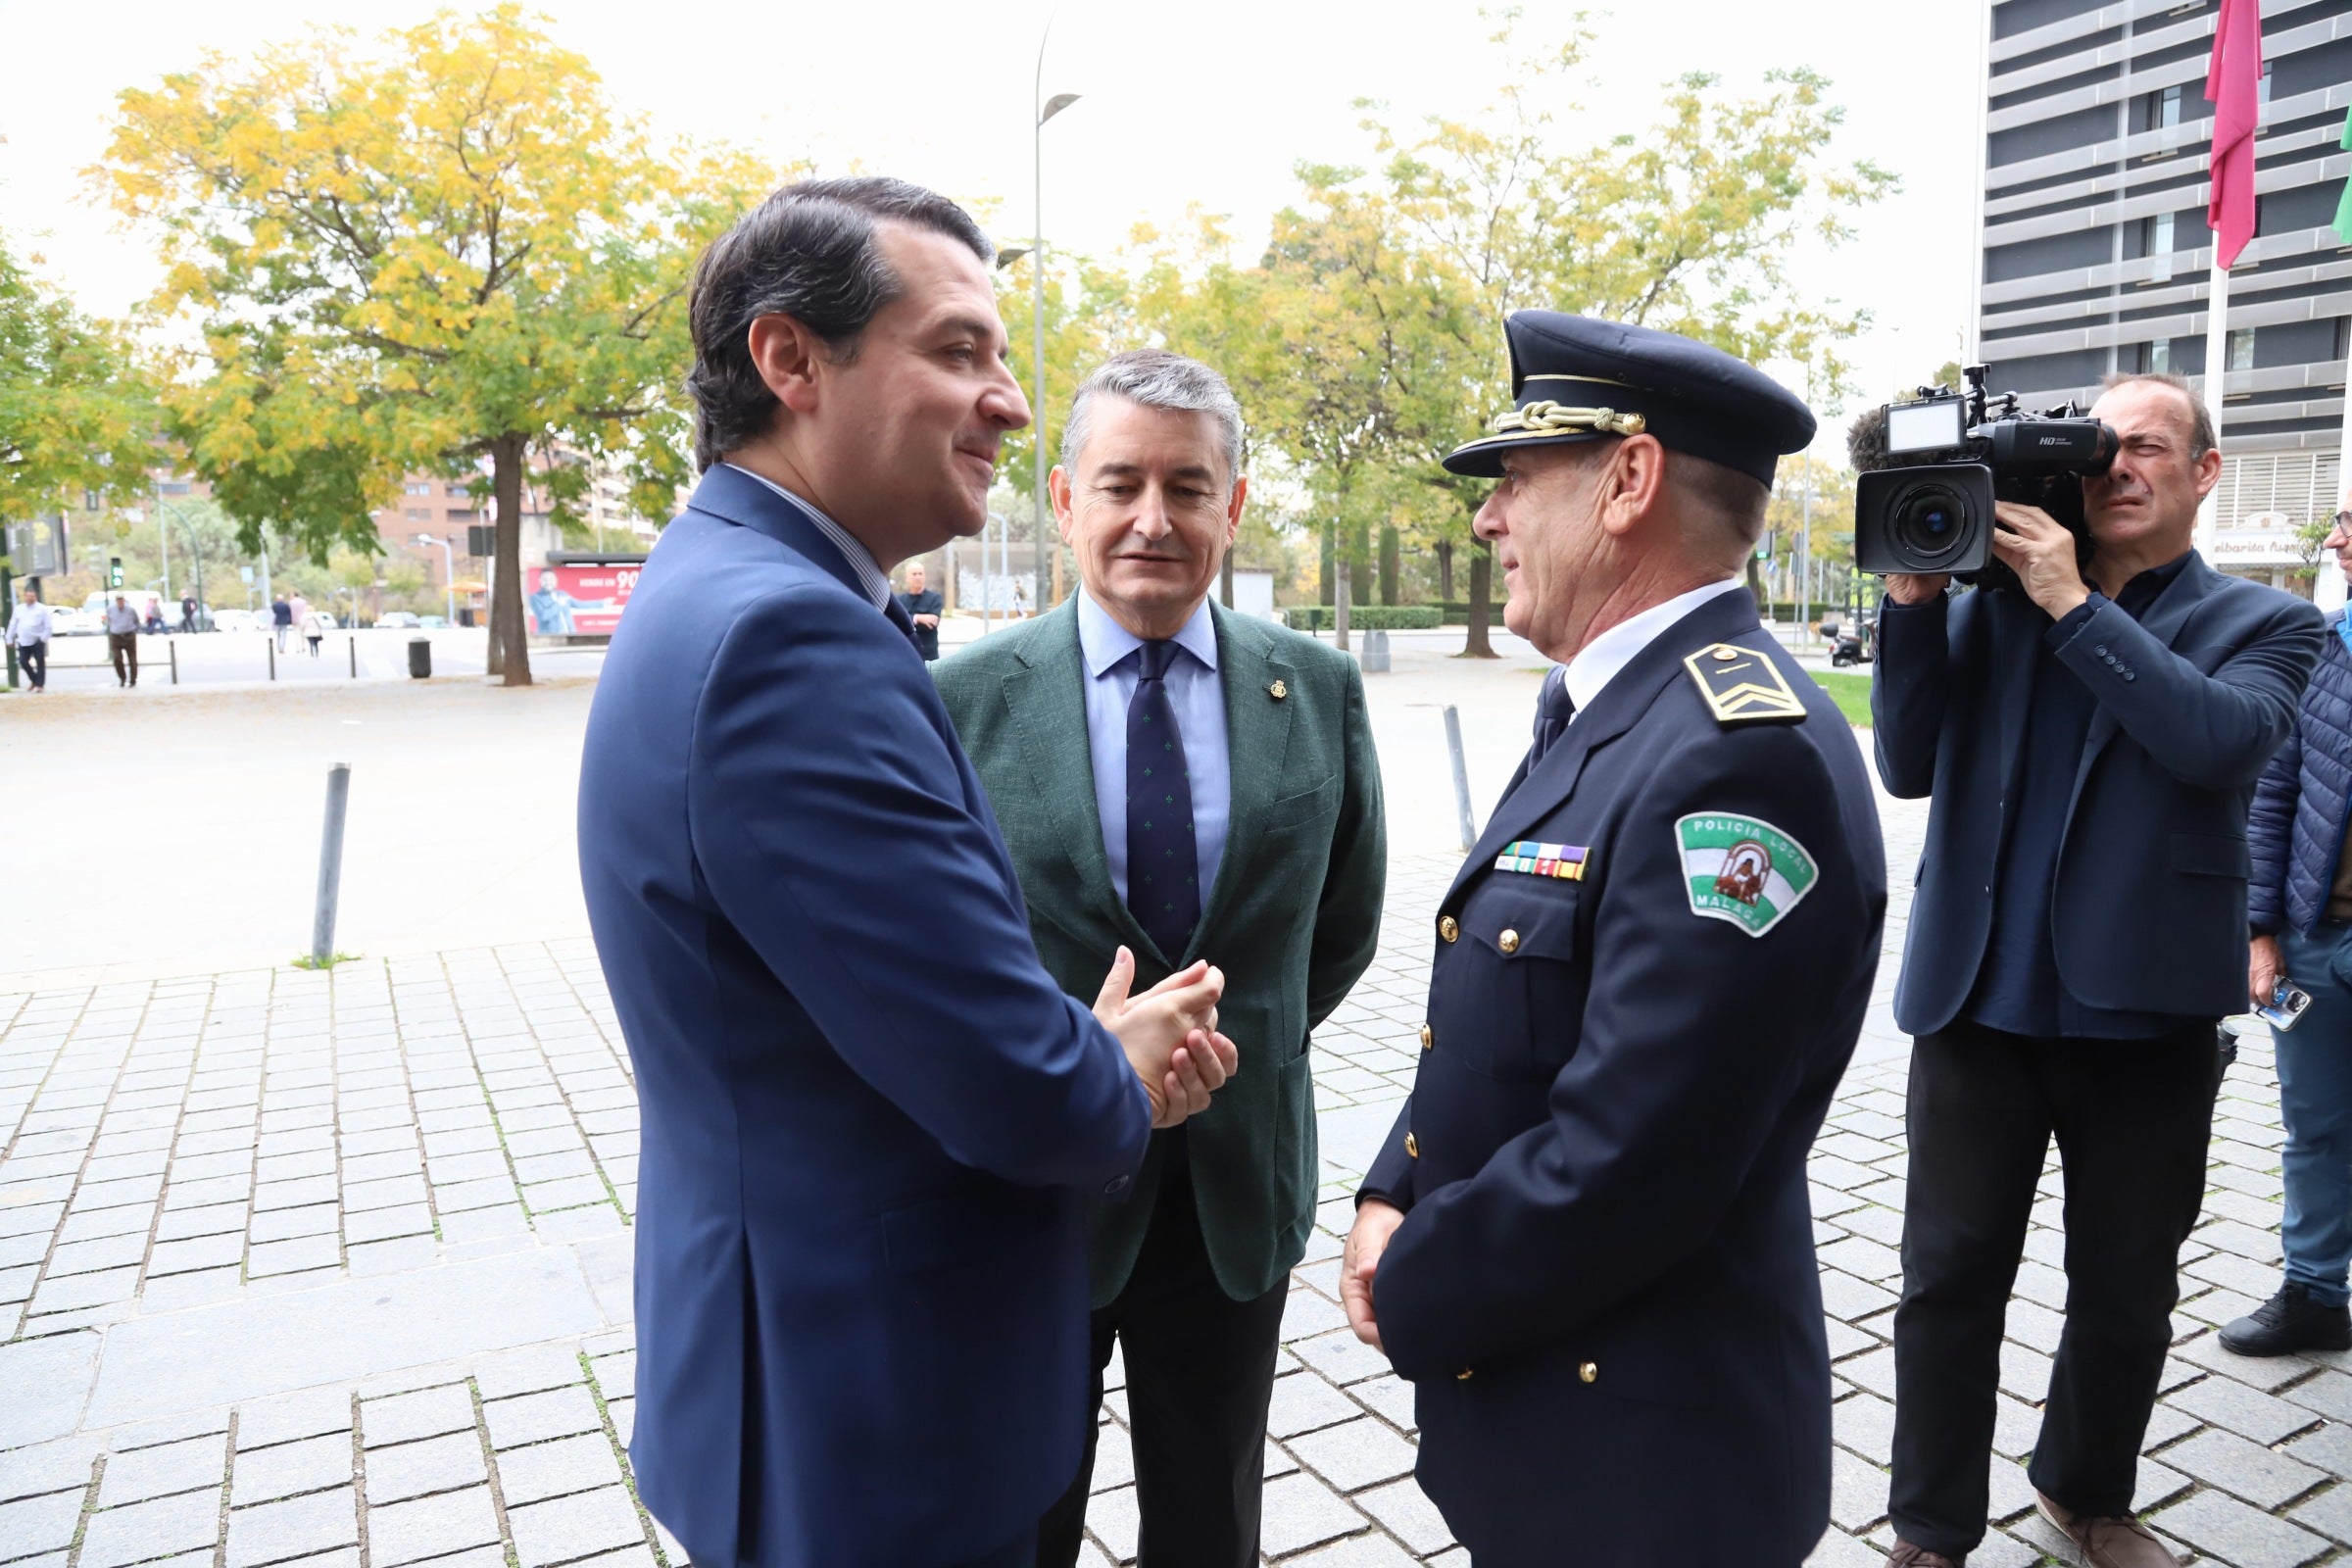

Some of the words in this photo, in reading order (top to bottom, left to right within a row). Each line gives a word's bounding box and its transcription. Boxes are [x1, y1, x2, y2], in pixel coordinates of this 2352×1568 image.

[616, 571, 639, 588] 90
[1694, 820, 1761, 837] POLICIA
[1770, 836, 1806, 874] LOCAL
[1697, 895, 1761, 927] MALAGA
